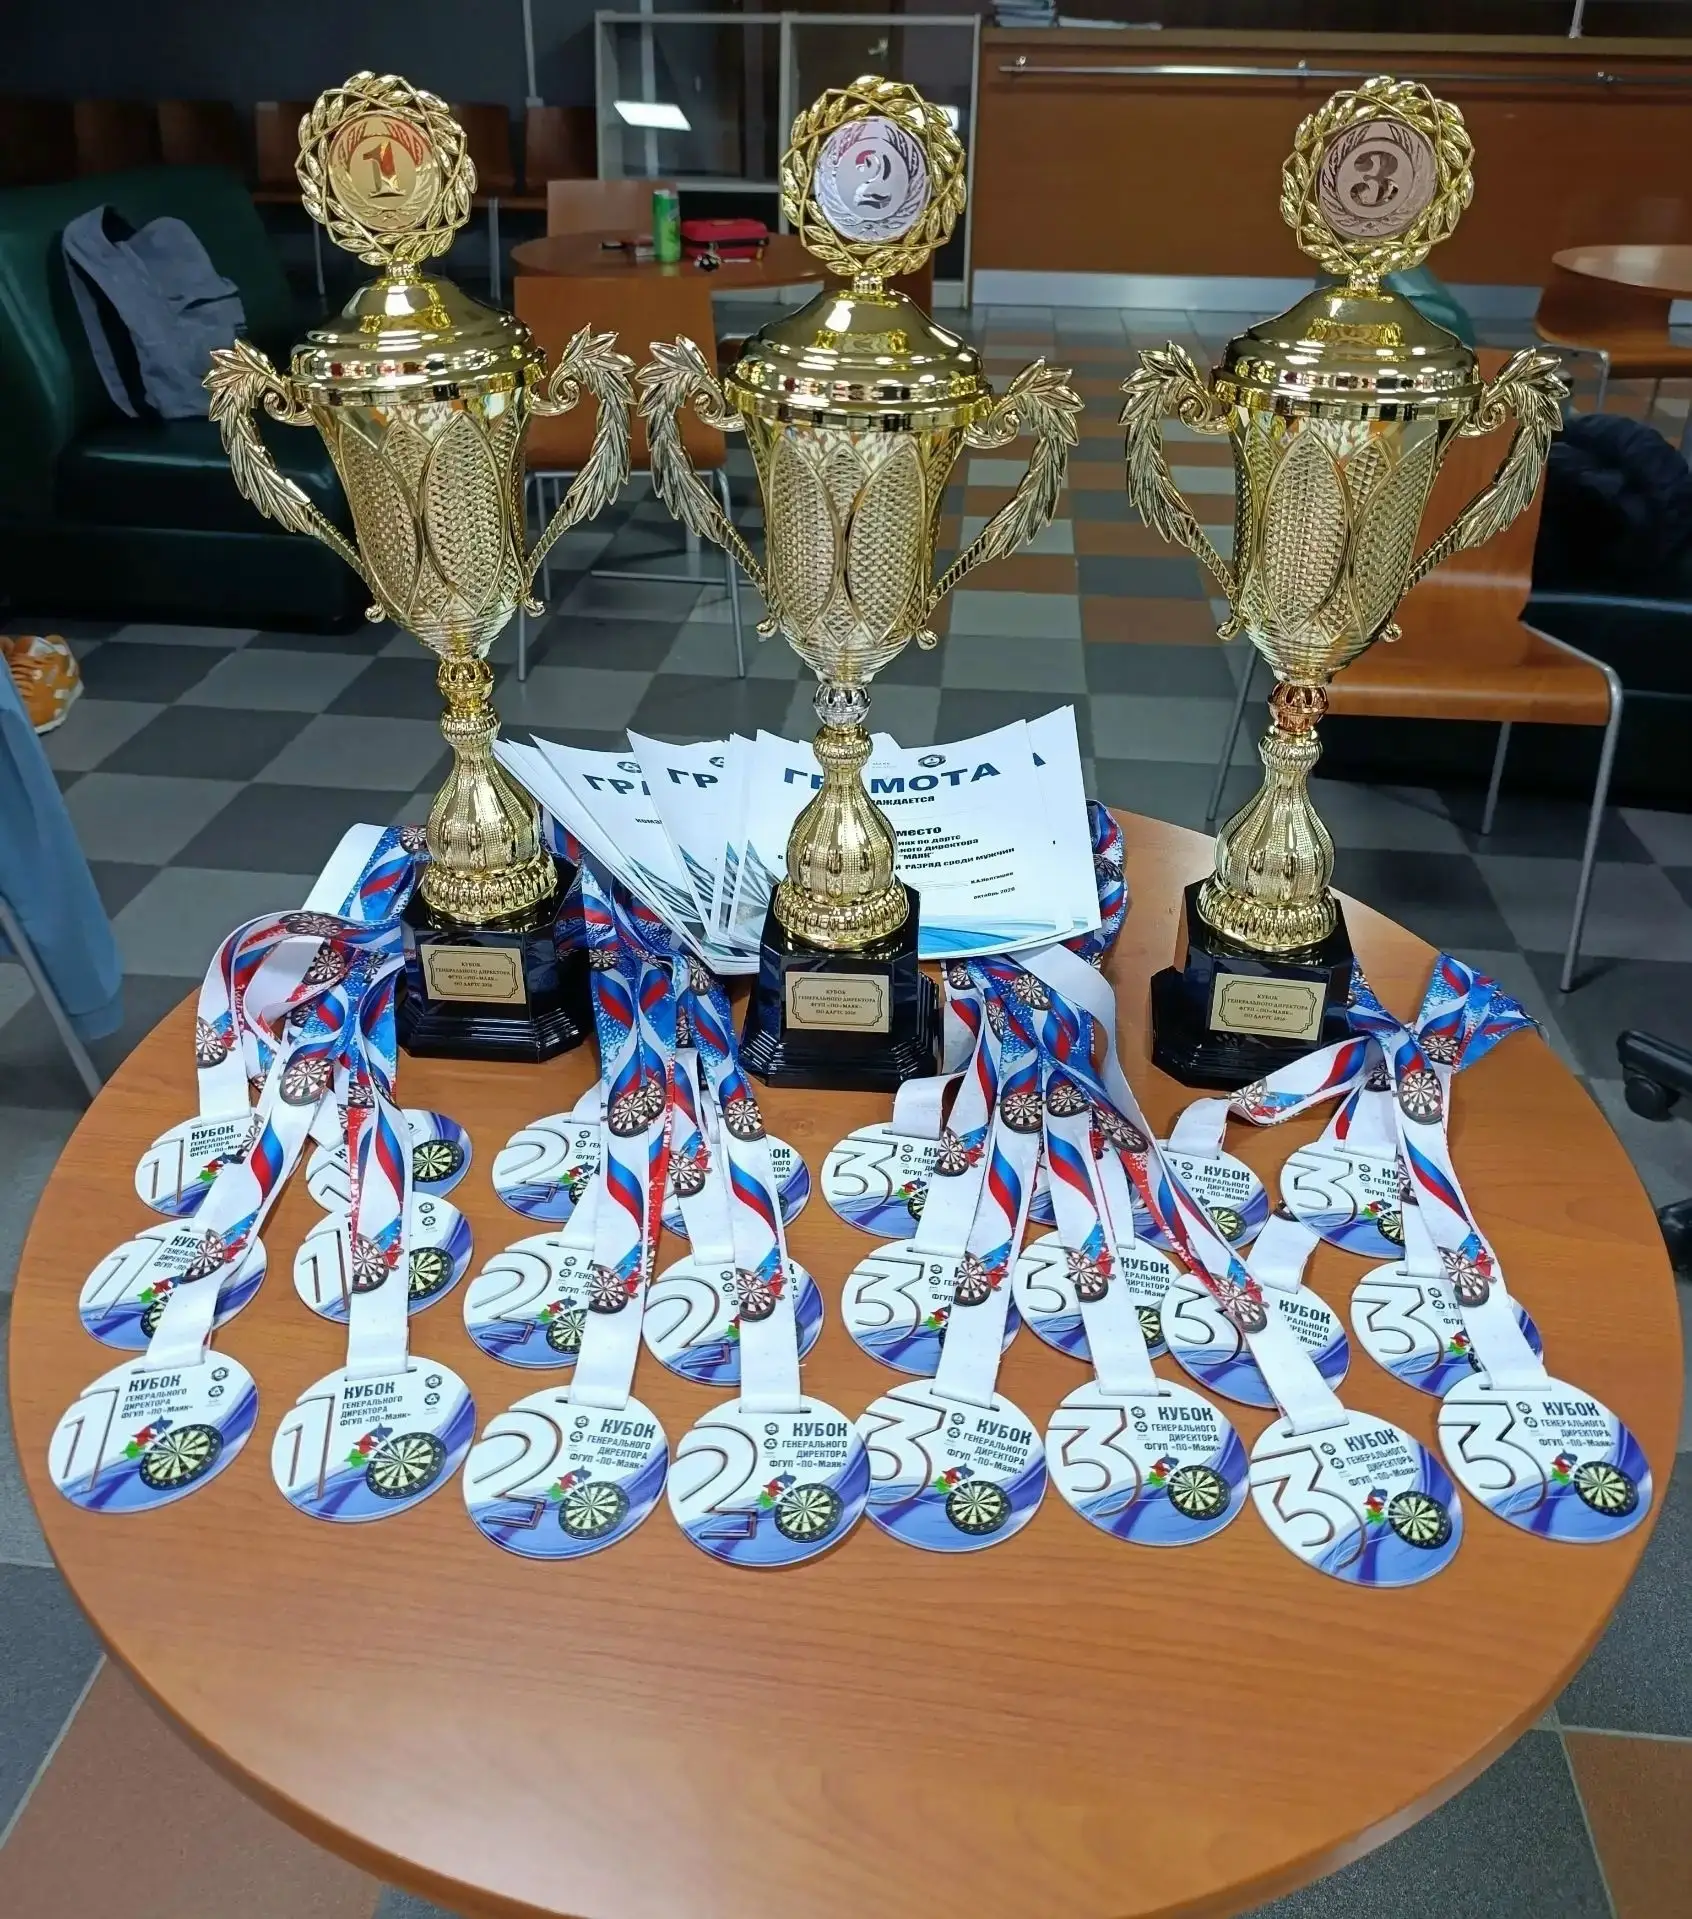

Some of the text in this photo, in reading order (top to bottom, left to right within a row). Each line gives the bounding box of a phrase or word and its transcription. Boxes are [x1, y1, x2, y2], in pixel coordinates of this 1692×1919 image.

[363, 141, 406, 198] 1
[853, 150, 892, 209] 2
[1350, 150, 1399, 207] 3
[872, 795, 935, 806] АЖДАЕТСЯ
[924, 838, 979, 851] директора
[931, 835, 961, 844] дартс
[944, 857, 973, 866] среди
[976, 847, 1014, 861] мужчин
[190, 1133, 242, 1147] ГЕНЕРАЛЬНОГО
[192, 1125, 235, 1140] КУБОК
[190, 1141, 229, 1153] ДИРЕКТОРА
[190, 1150, 209, 1158] ФГУП
[832, 1138, 898, 1209] 3
[903, 1169, 922, 1177] ФГУП
[1204, 1165, 1250, 1182] КУБОК
[1195, 1175, 1250, 1189] ГЕНЕРАЛЬНОГО
[1287, 1148, 1358, 1227] 3
[1207, 1184, 1249, 1196] ДИРЕКТОРА
[154, 1261, 173, 1269] ФГУП
[1120, 1257, 1169, 1275] КУБОК
[473, 1248, 552, 1344] 2
[558, 1286, 579, 1294] ФГУП
[854, 1255, 924, 1345] 3
[1279, 1299, 1330, 1325] КУБОК
[656, 1275, 730, 1369] 2
[1284, 1314, 1329, 1334] РАЛЬНОГО
[1352, 1282, 1443, 1374] 3
[1289, 1324, 1328, 1341] РЕКТОРА
[129, 1374, 181, 1392] КУБОК
[344, 1381, 395, 1399] КУБОК
[126, 1388, 187, 1402] ГЕНЕРАЛЬНОГО
[342, 1395, 403, 1409] ГЕНЕРАЛЬНОГО
[123, 1398, 171, 1412] ДИРЕКТОРА
[340, 1406, 388, 1419] ДИРЕКТОРА
[1542, 1402, 1600, 1416] КУБОК
[121, 1409, 144, 1419] ФГУП
[1157, 1406, 1214, 1421] КУБОК
[340, 1417, 363, 1426] ФГУП
[601, 1418, 656, 1438] КУБОК
[1151, 1424, 1217, 1432] ГЕНЕРАЛЬНОГО
[1540, 1419, 1606, 1427] ГЕНЕРАЛЬНОГО
[793, 1422, 848, 1437] КУБОК
[976, 1419, 1032, 1445] КУБОК
[1560, 1429, 1611, 1438] ДИРЕКТОРА
[587, 1434, 651, 1450] ГЕНЕРАЛЬНОГО
[782, 1440, 848, 1448] ГЕНЕРАЛЬНОГО
[963, 1433, 1028, 1456] ГЕНЕРАЛЬНОГО
[1169, 1434, 1220, 1442] ДИРЕКТОРА
[1344, 1428, 1400, 1452] КУБОК
[1539, 1439, 1564, 1447] ФГУП
[597, 1447, 648, 1460] ДИРЕКТОРА
[796, 1450, 848, 1458] ДИРЕКТОРА
[865, 1398, 946, 1505] 3
[947, 1448, 971, 1461] ФГУП
[1144, 1443, 1168, 1451] ФГУП
[569, 1453, 594, 1463] ФГУП
[975, 1446, 1025, 1466] ДИРЕКТОРА
[1048, 1404, 1142, 1515] 3
[1345, 1445, 1408, 1465] ГЕНЕРАЛЬНОГО
[1440, 1400, 1548, 1512] 3
[473, 1408, 562, 1529] 2
[769, 1460, 794, 1468] ФГУП
[1366, 1455, 1415, 1473] ДИРЕКТОРА
[680, 1424, 757, 1539] 2
[1348, 1475, 1373, 1486] ФГУП
[1251, 1447, 1367, 1568] 3
